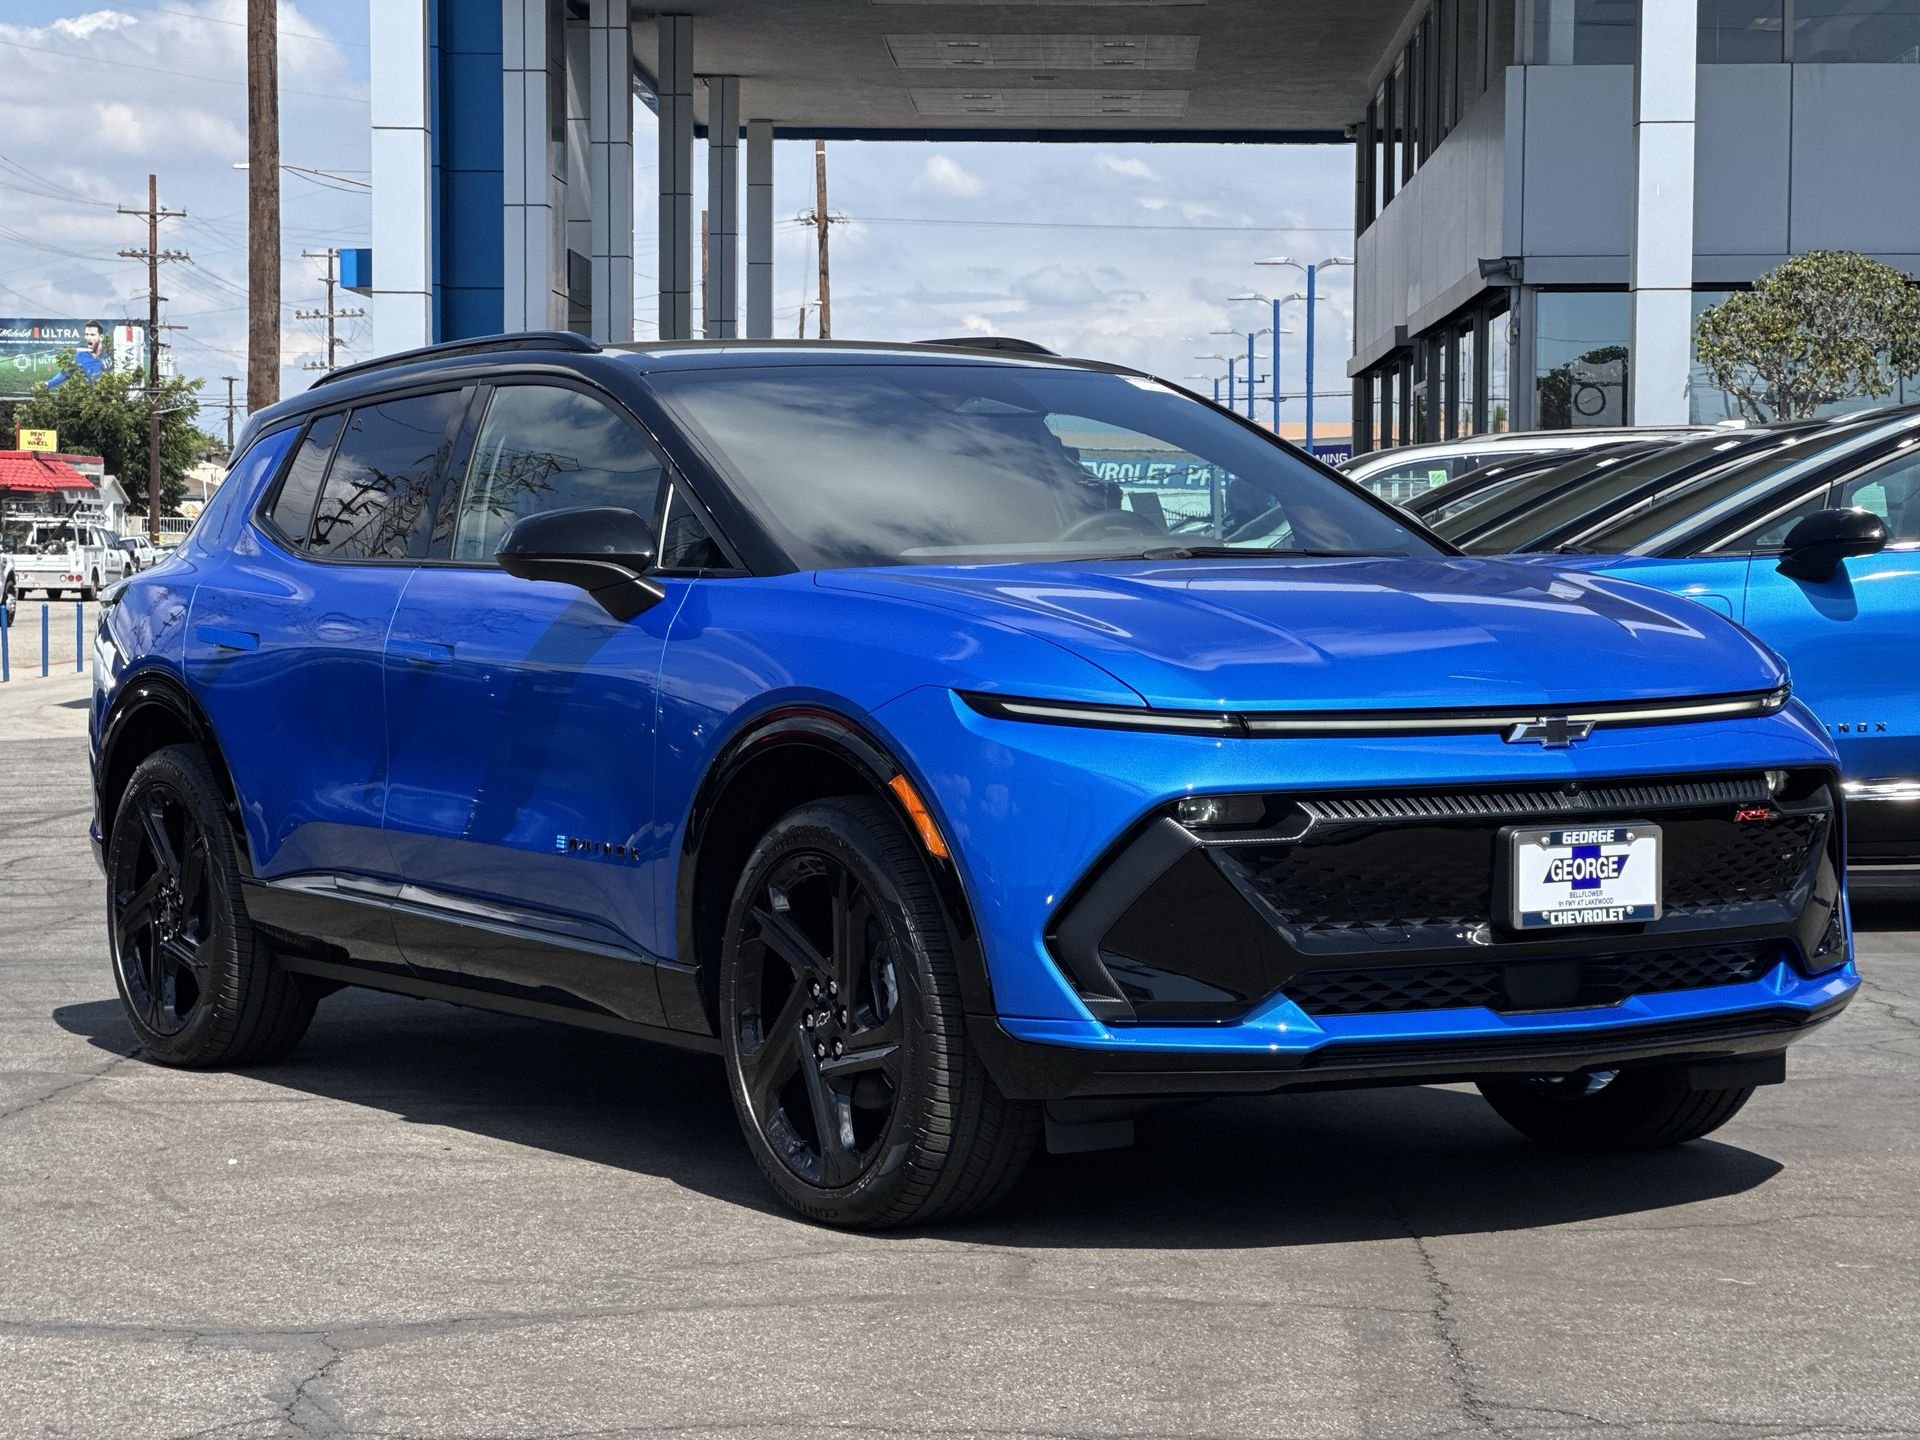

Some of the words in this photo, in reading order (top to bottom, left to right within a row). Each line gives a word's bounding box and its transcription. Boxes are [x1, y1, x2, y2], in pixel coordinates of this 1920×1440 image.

[41, 328, 80, 338] ULTRA
[1315, 452, 1348, 463] MING
[1826, 721, 1887, 733] INOX
[1562, 829, 1615, 844] GEORGE
[1550, 856, 1619, 881] GEORGE
[1569, 890, 1603, 898] BELLFLOWER
[1585, 897, 1614, 906] LAKEWOOD
[1550, 907, 1625, 925] CHEVROLET
